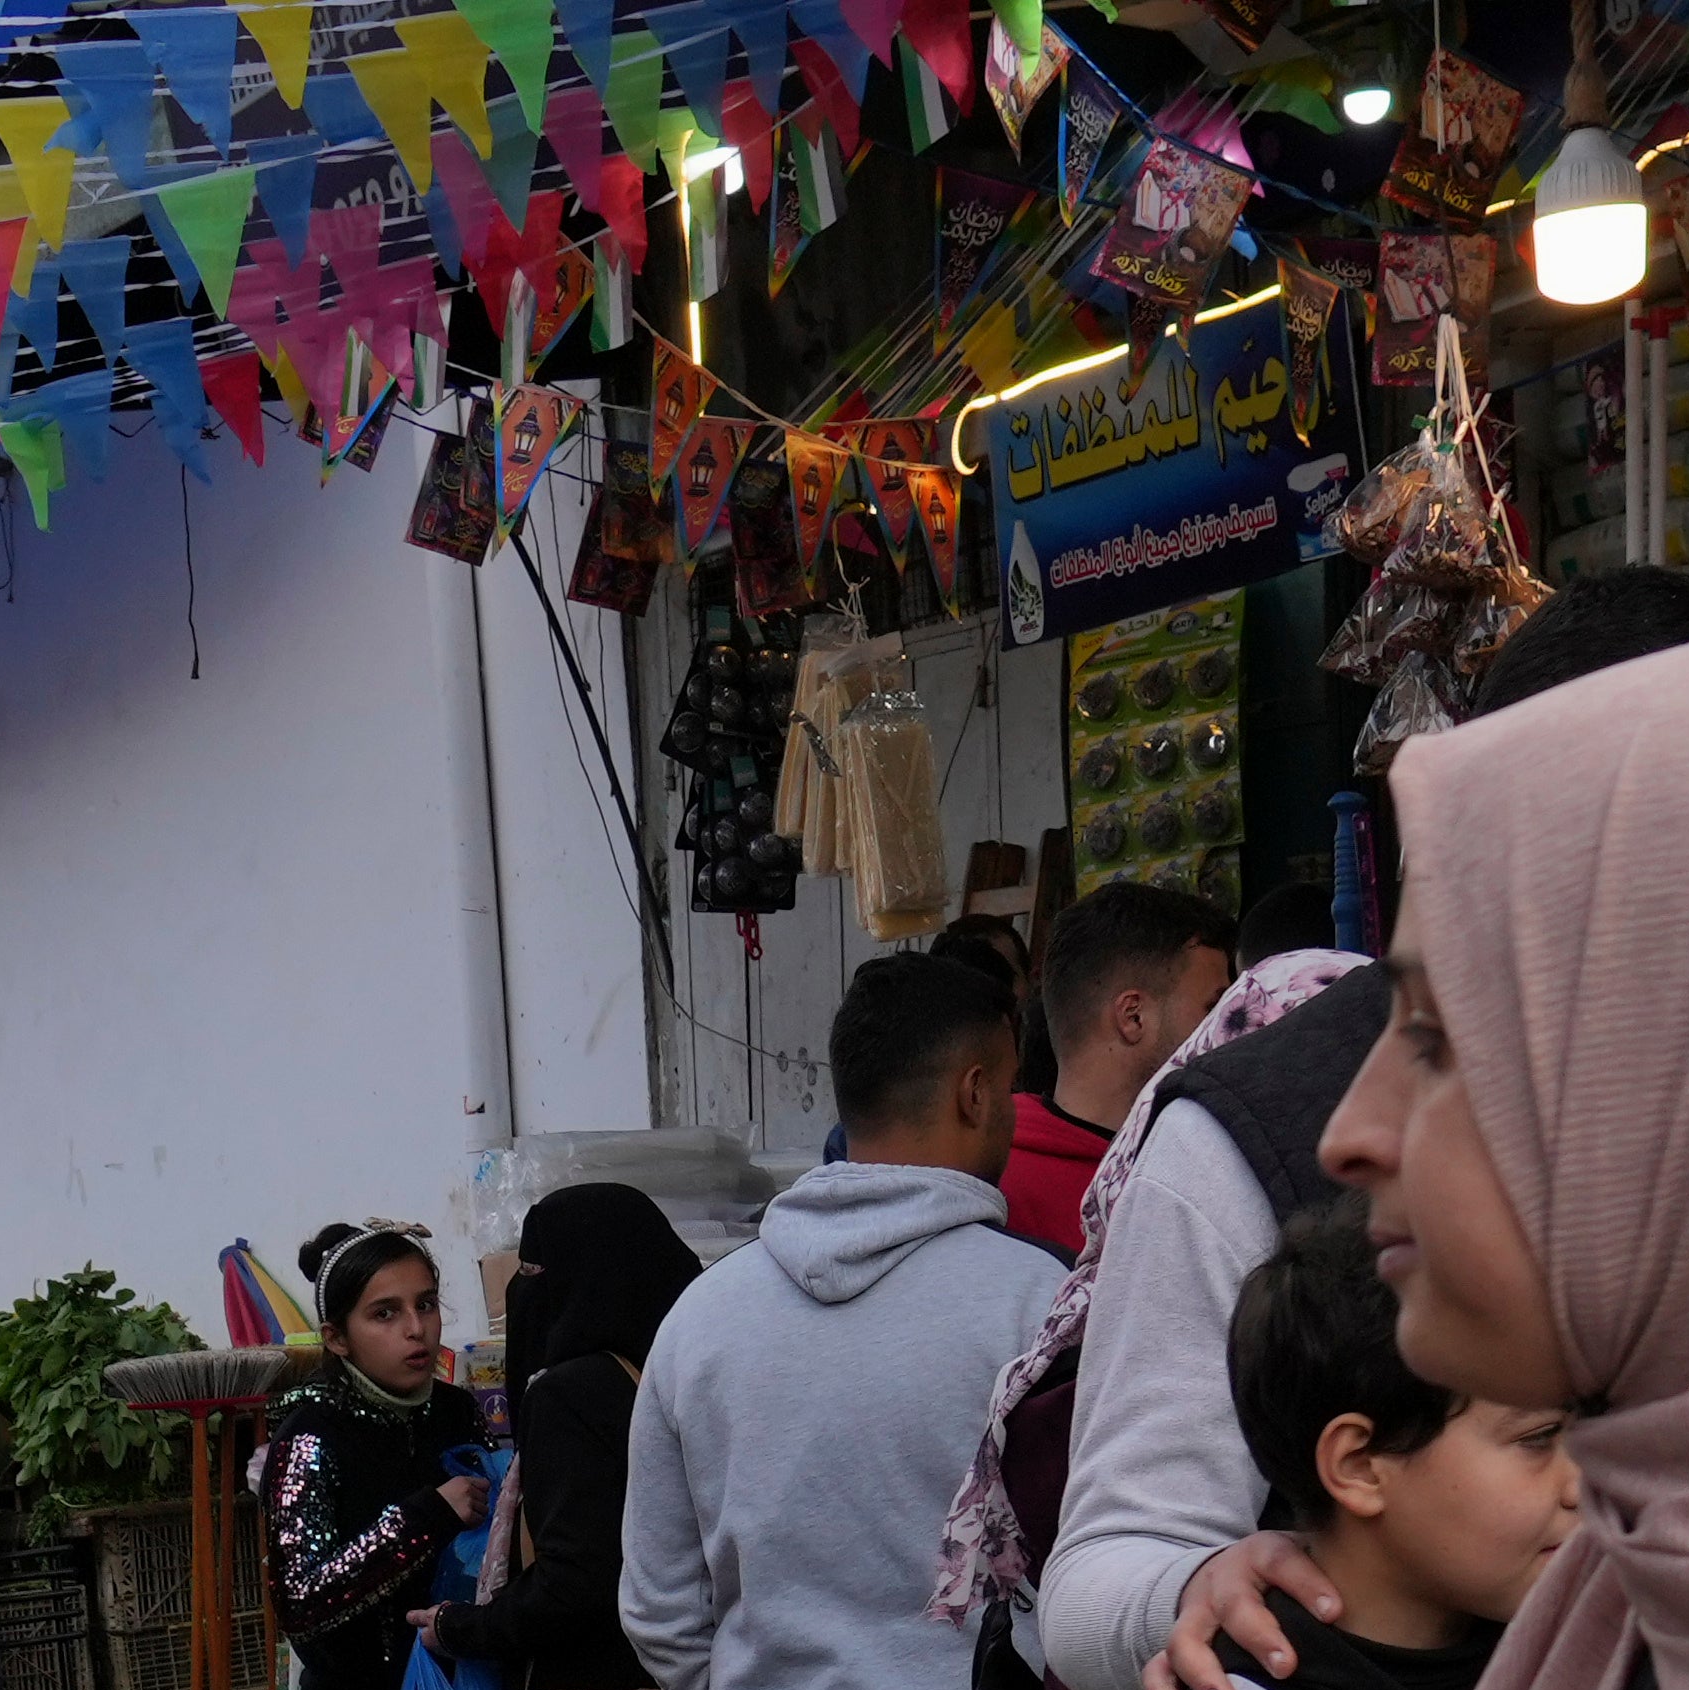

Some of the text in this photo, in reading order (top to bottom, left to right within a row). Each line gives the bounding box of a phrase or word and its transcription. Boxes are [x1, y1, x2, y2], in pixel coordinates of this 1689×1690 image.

[1007, 358, 1202, 503] للمنظفات
[1049, 495, 1279, 589] تسويق وتوزيع جميع أنواع المنظفات
[1303, 480, 1343, 519] Selpak
